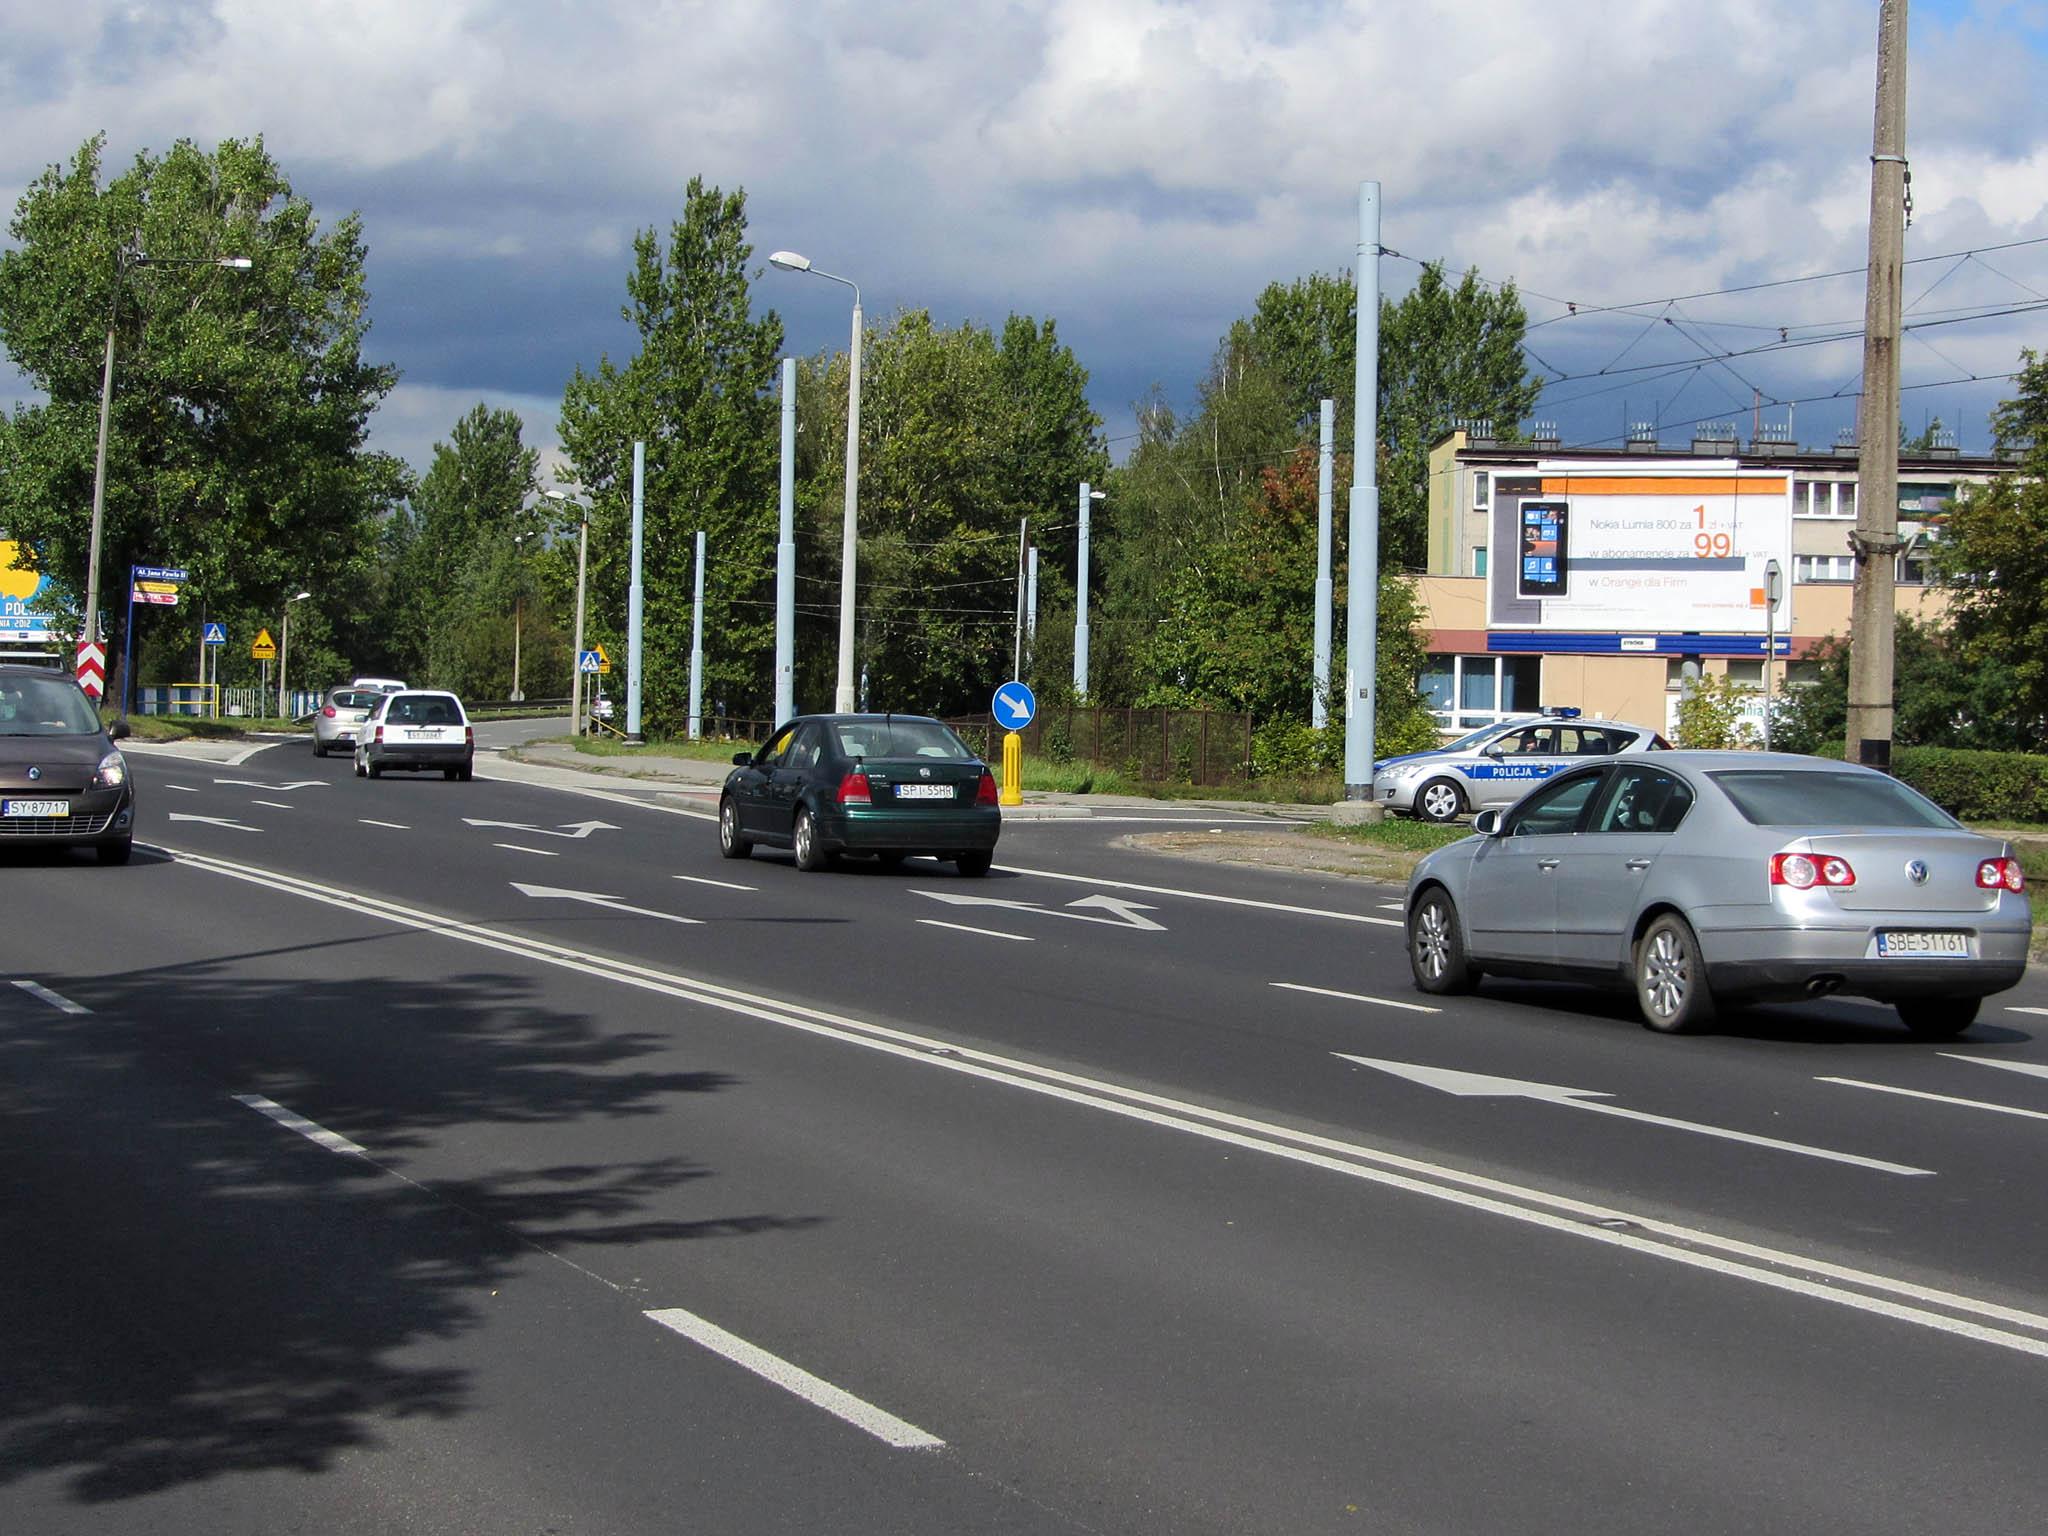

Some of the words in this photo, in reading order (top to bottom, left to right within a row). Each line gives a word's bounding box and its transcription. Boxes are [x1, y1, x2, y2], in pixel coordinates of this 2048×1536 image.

[1590, 519, 1619, 530] Nokia
[1622, 519, 1653, 530] Lumia
[1656, 519, 1677, 530] 800
[1679, 521, 1692, 530] za
[1693, 504, 1705, 530] 1
[1589, 551, 1599, 559] w
[1677, 551, 1690, 559] za
[1694, 533, 1730, 559] 99
[1588, 579, 1599, 587] w
[1601, 577, 1641, 589] Orange
[1643, 577, 1661, 588] dla
[1663, 577, 1688, 588] Firm
[14, 619, 32, 628] 2012
[1492, 767, 1533, 777] POLICJA
[11, 802, 27, 813] SY
[31, 802, 67, 813] 87717
[1887, 934, 1916, 951] SBE
[1921, 935, 1965, 951] 51161
